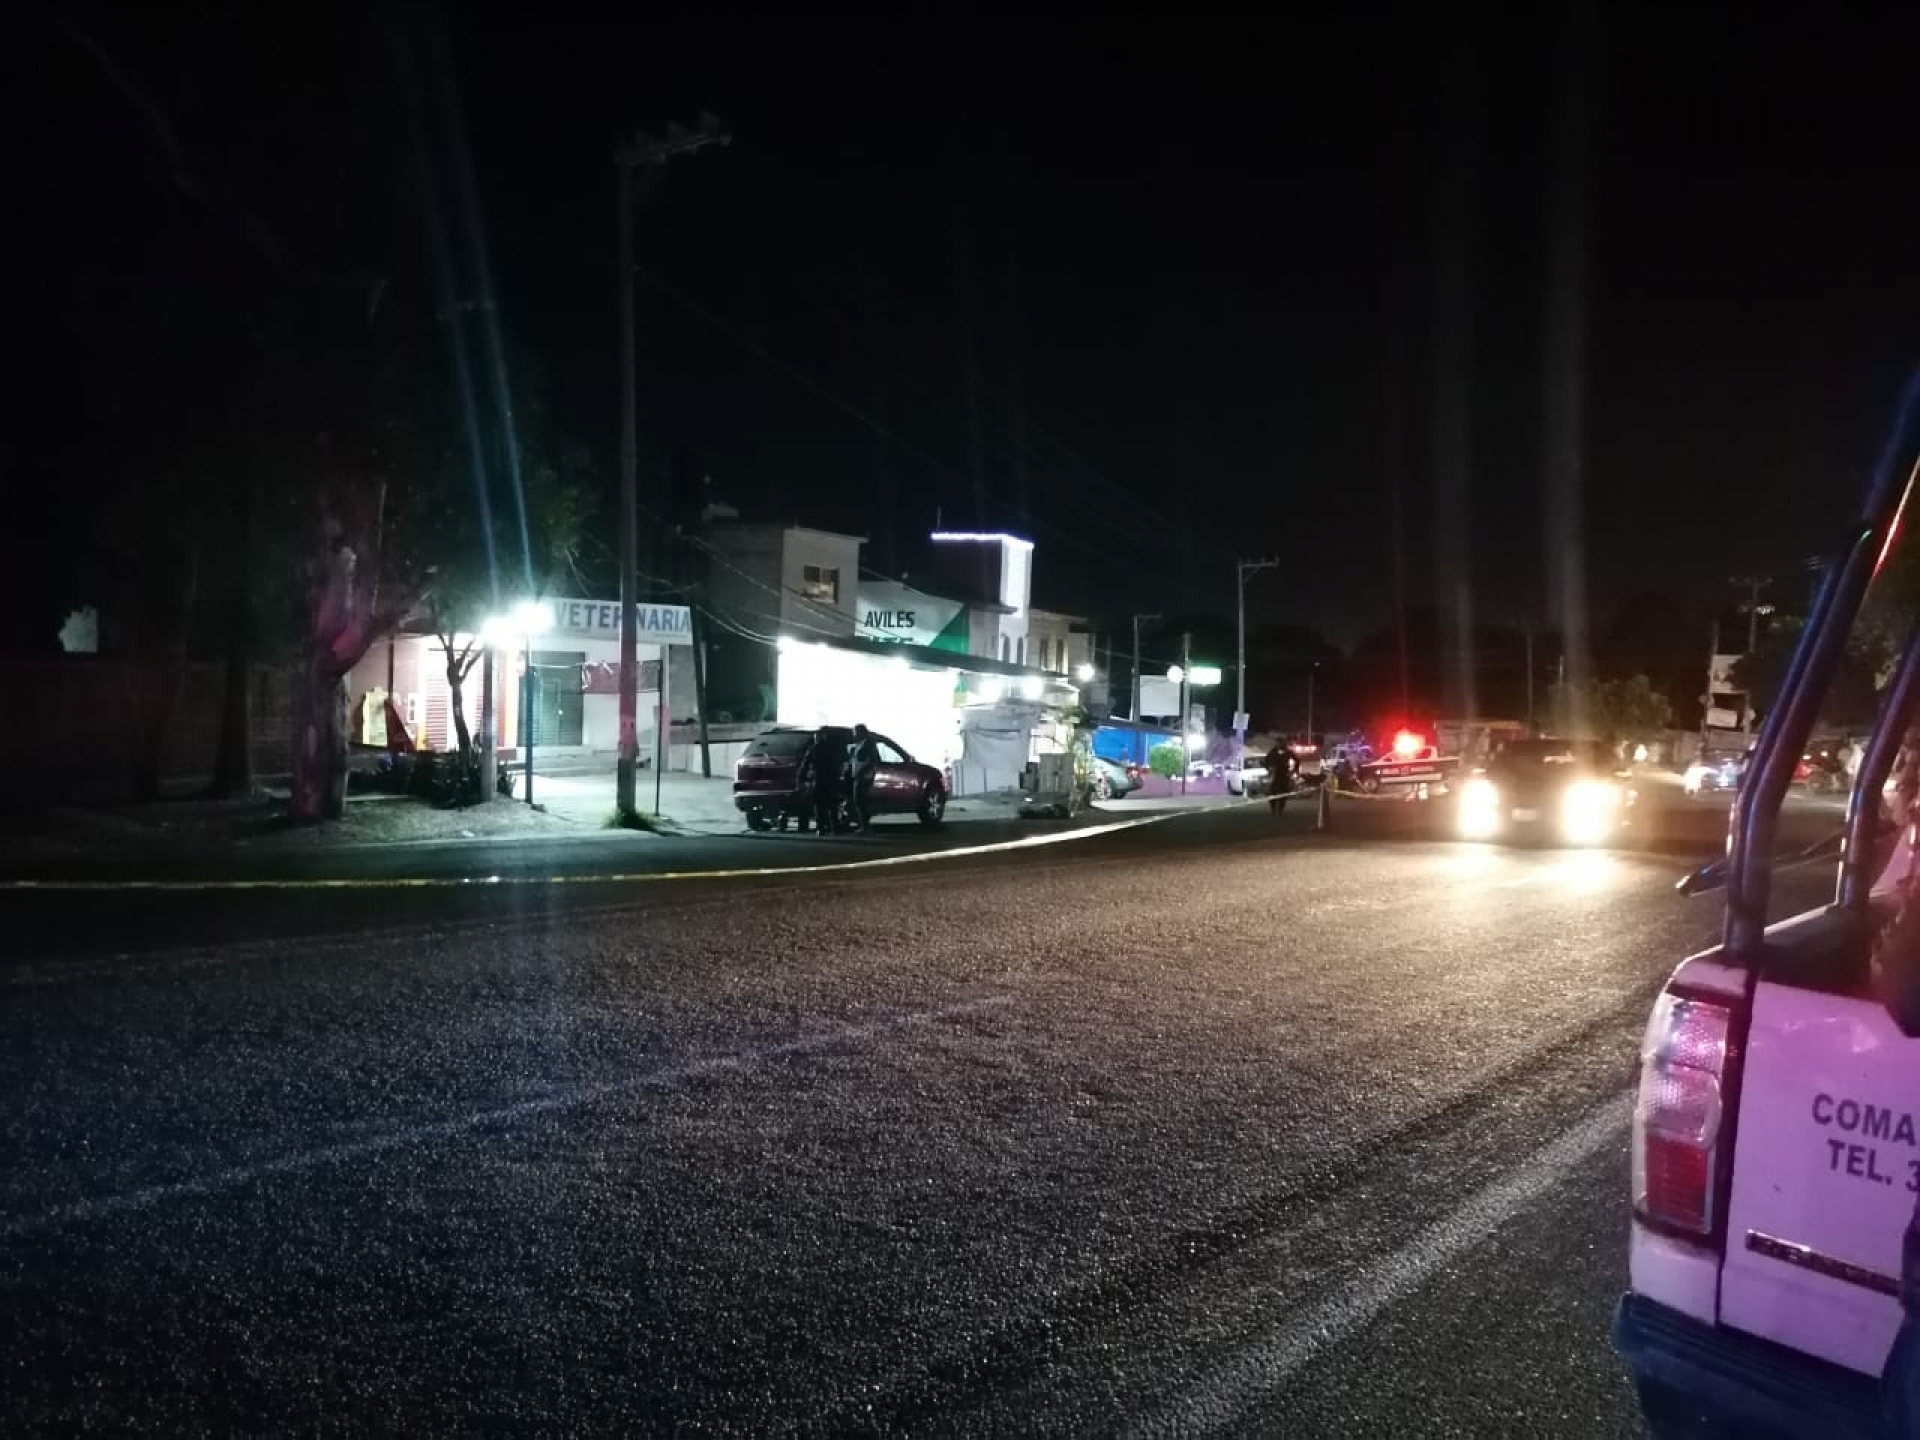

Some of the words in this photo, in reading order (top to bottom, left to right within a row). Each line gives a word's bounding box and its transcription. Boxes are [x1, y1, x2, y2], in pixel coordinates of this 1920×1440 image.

[554, 602, 690, 631] VETERNARIA
[864, 611, 915, 628] AVILES
[1827, 1137, 1892, 1186] TEL.
